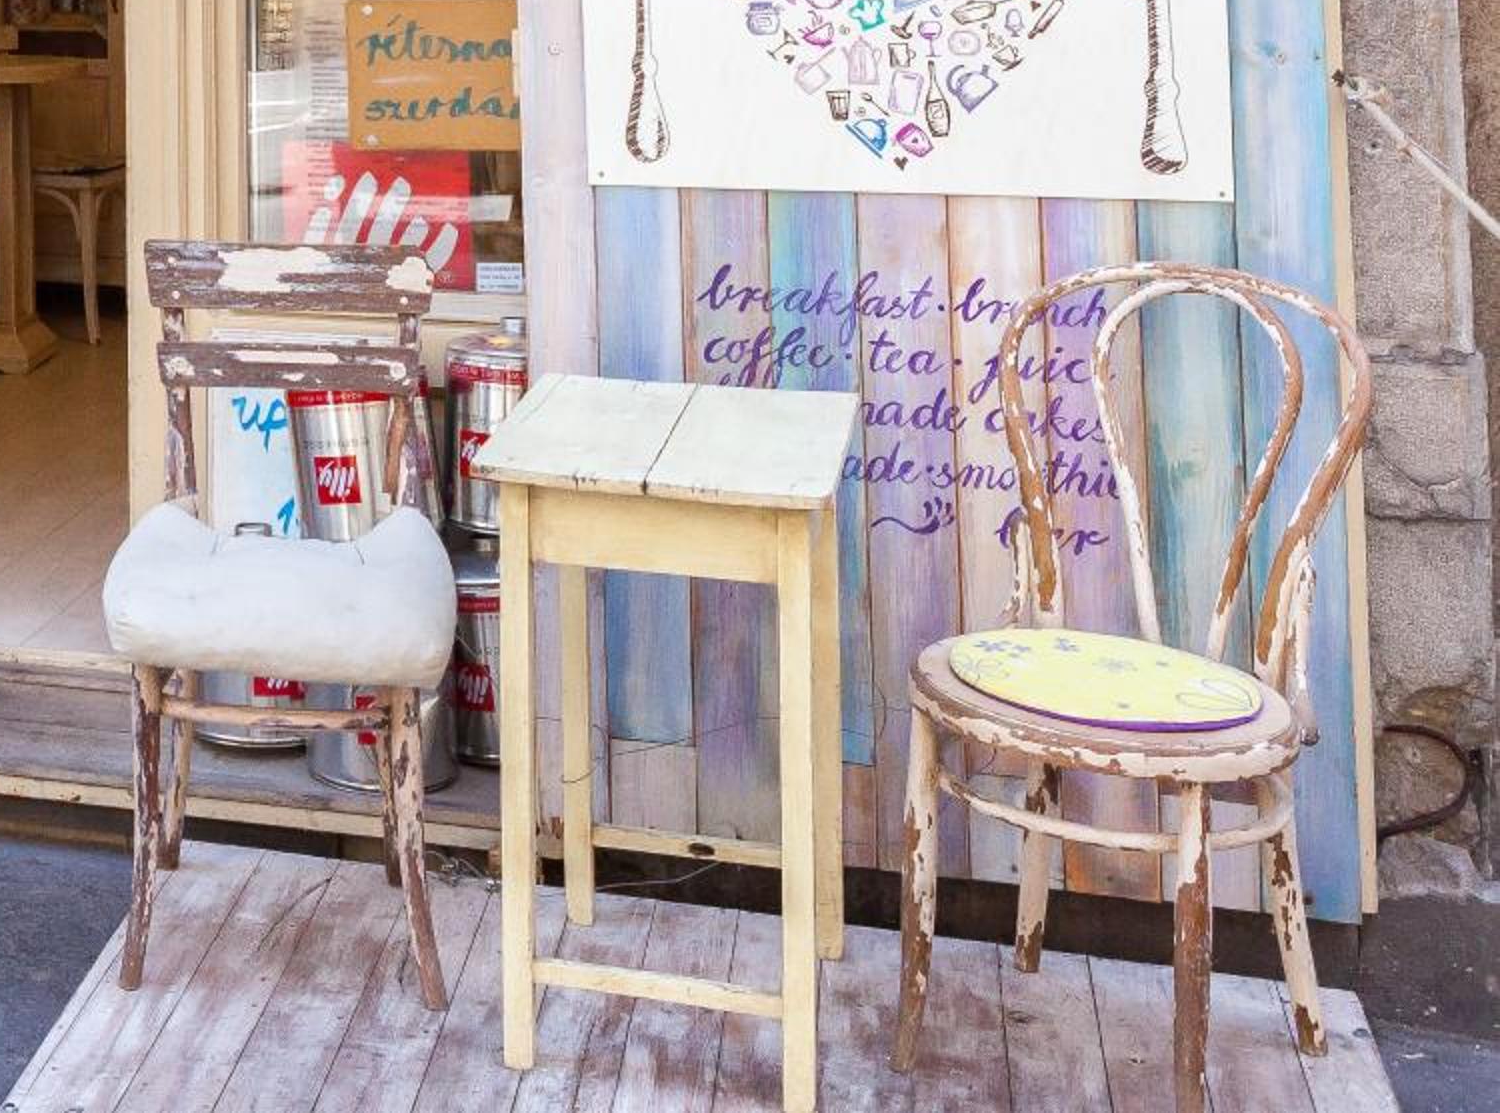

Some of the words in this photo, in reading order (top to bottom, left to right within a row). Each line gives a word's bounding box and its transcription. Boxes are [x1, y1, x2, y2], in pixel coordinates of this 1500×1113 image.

[695, 263, 934, 345] breakfast
[703, 326, 835, 387] coffee
[868, 329, 950, 376] tea
[967, 347, 1100, 405] juic
[318, 460, 357, 498] illy
